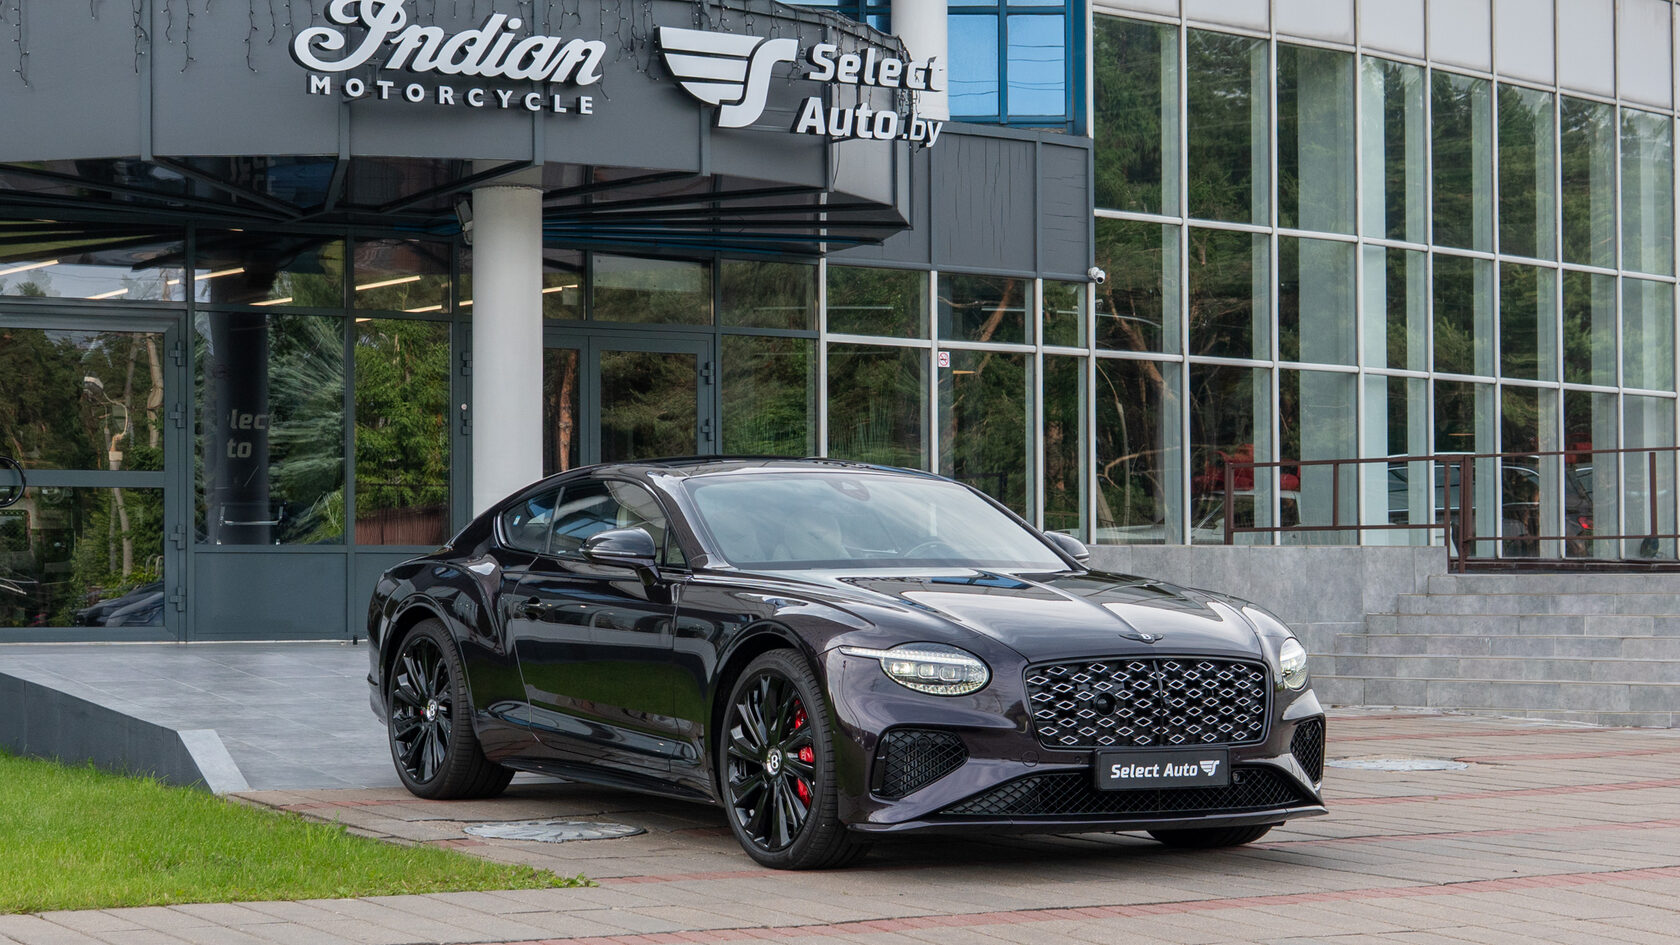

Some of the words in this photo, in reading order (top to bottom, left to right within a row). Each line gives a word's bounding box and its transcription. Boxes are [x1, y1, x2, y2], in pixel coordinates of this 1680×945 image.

[293, 0, 606, 86] Indian
[808, 43, 944, 91] Select
[309, 74, 593, 115] MOTORCYCLE
[796, 96, 943, 148] Auto.by
[771, 755, 779, 769] B
[1111, 764, 1160, 779] Select
[1163, 763, 1198, 777] Auto
